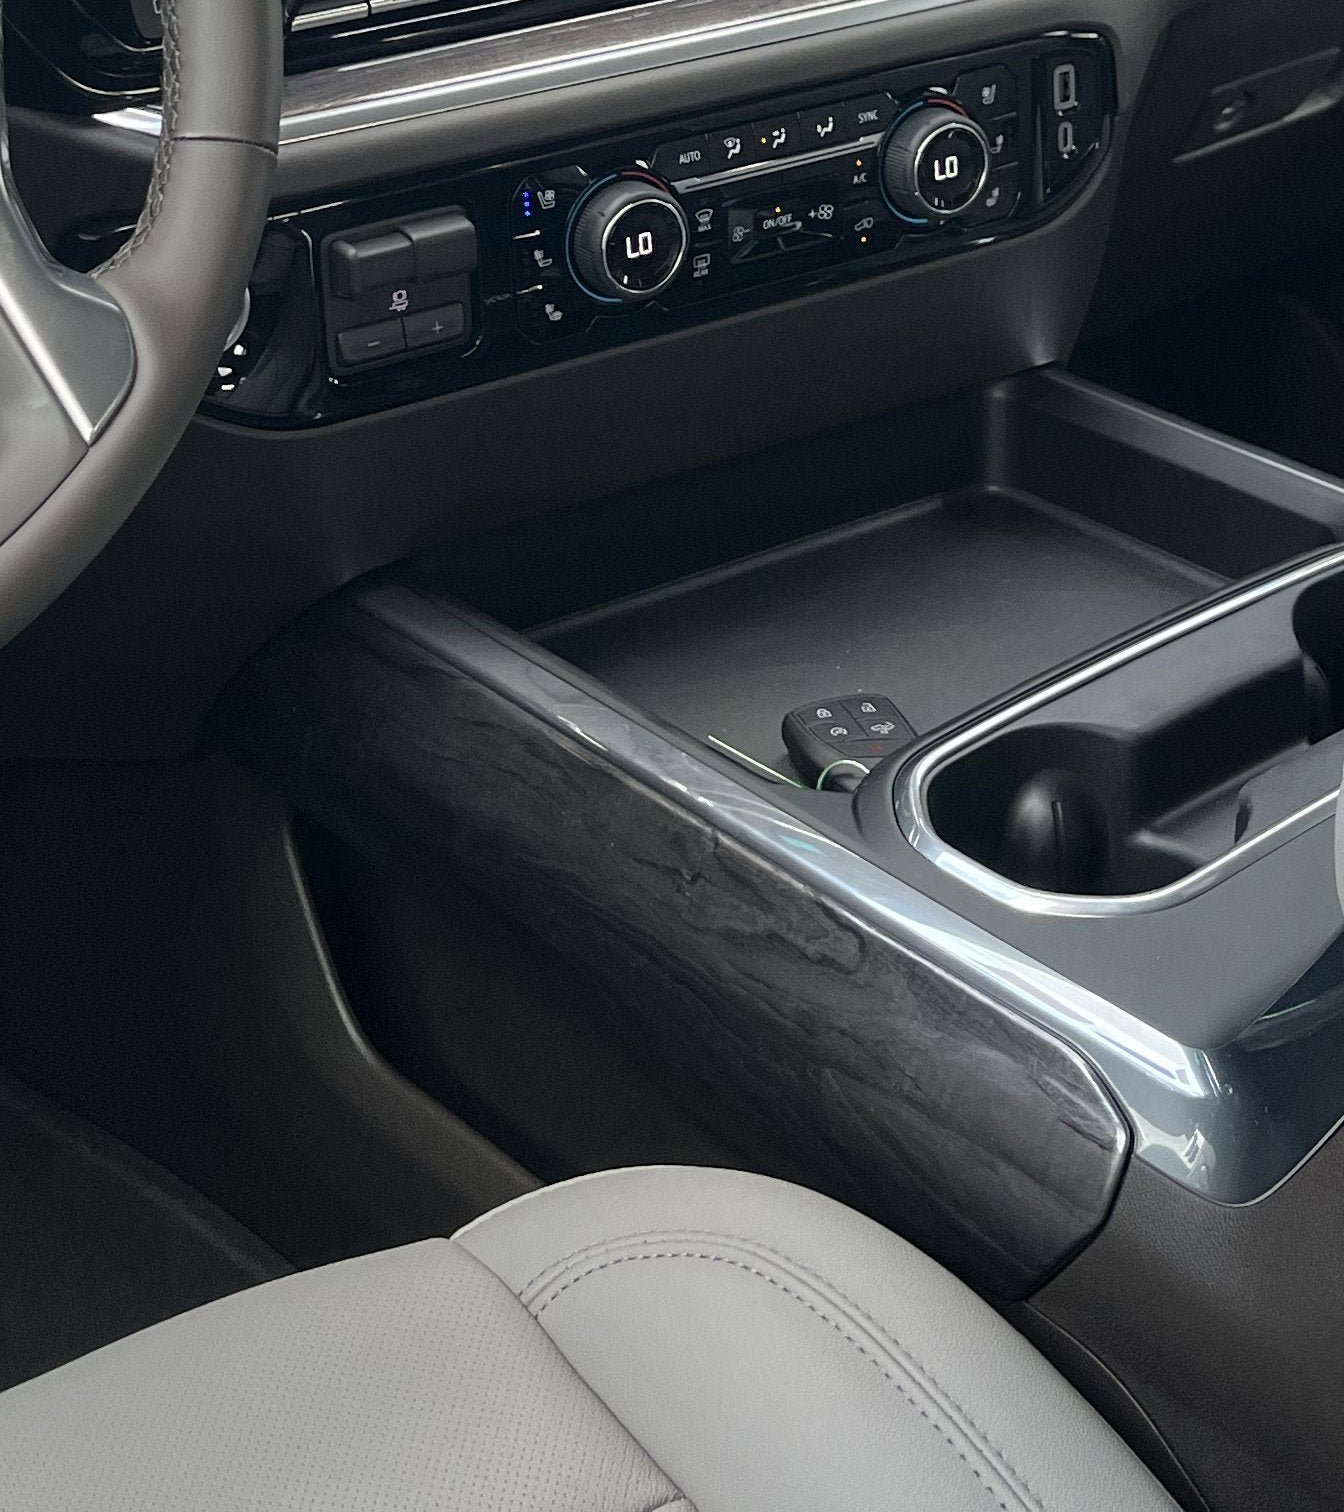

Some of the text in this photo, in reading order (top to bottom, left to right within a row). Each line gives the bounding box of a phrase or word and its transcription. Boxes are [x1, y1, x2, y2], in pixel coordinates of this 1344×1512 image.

[858, 109, 879, 124] SYNC
[679, 150, 701, 165] AUTO
[934, 155, 958, 181] LO
[853, 172, 868, 185] A/C
[762, 213, 793, 229] ON/OFF
[626, 231, 652, 259] LO
